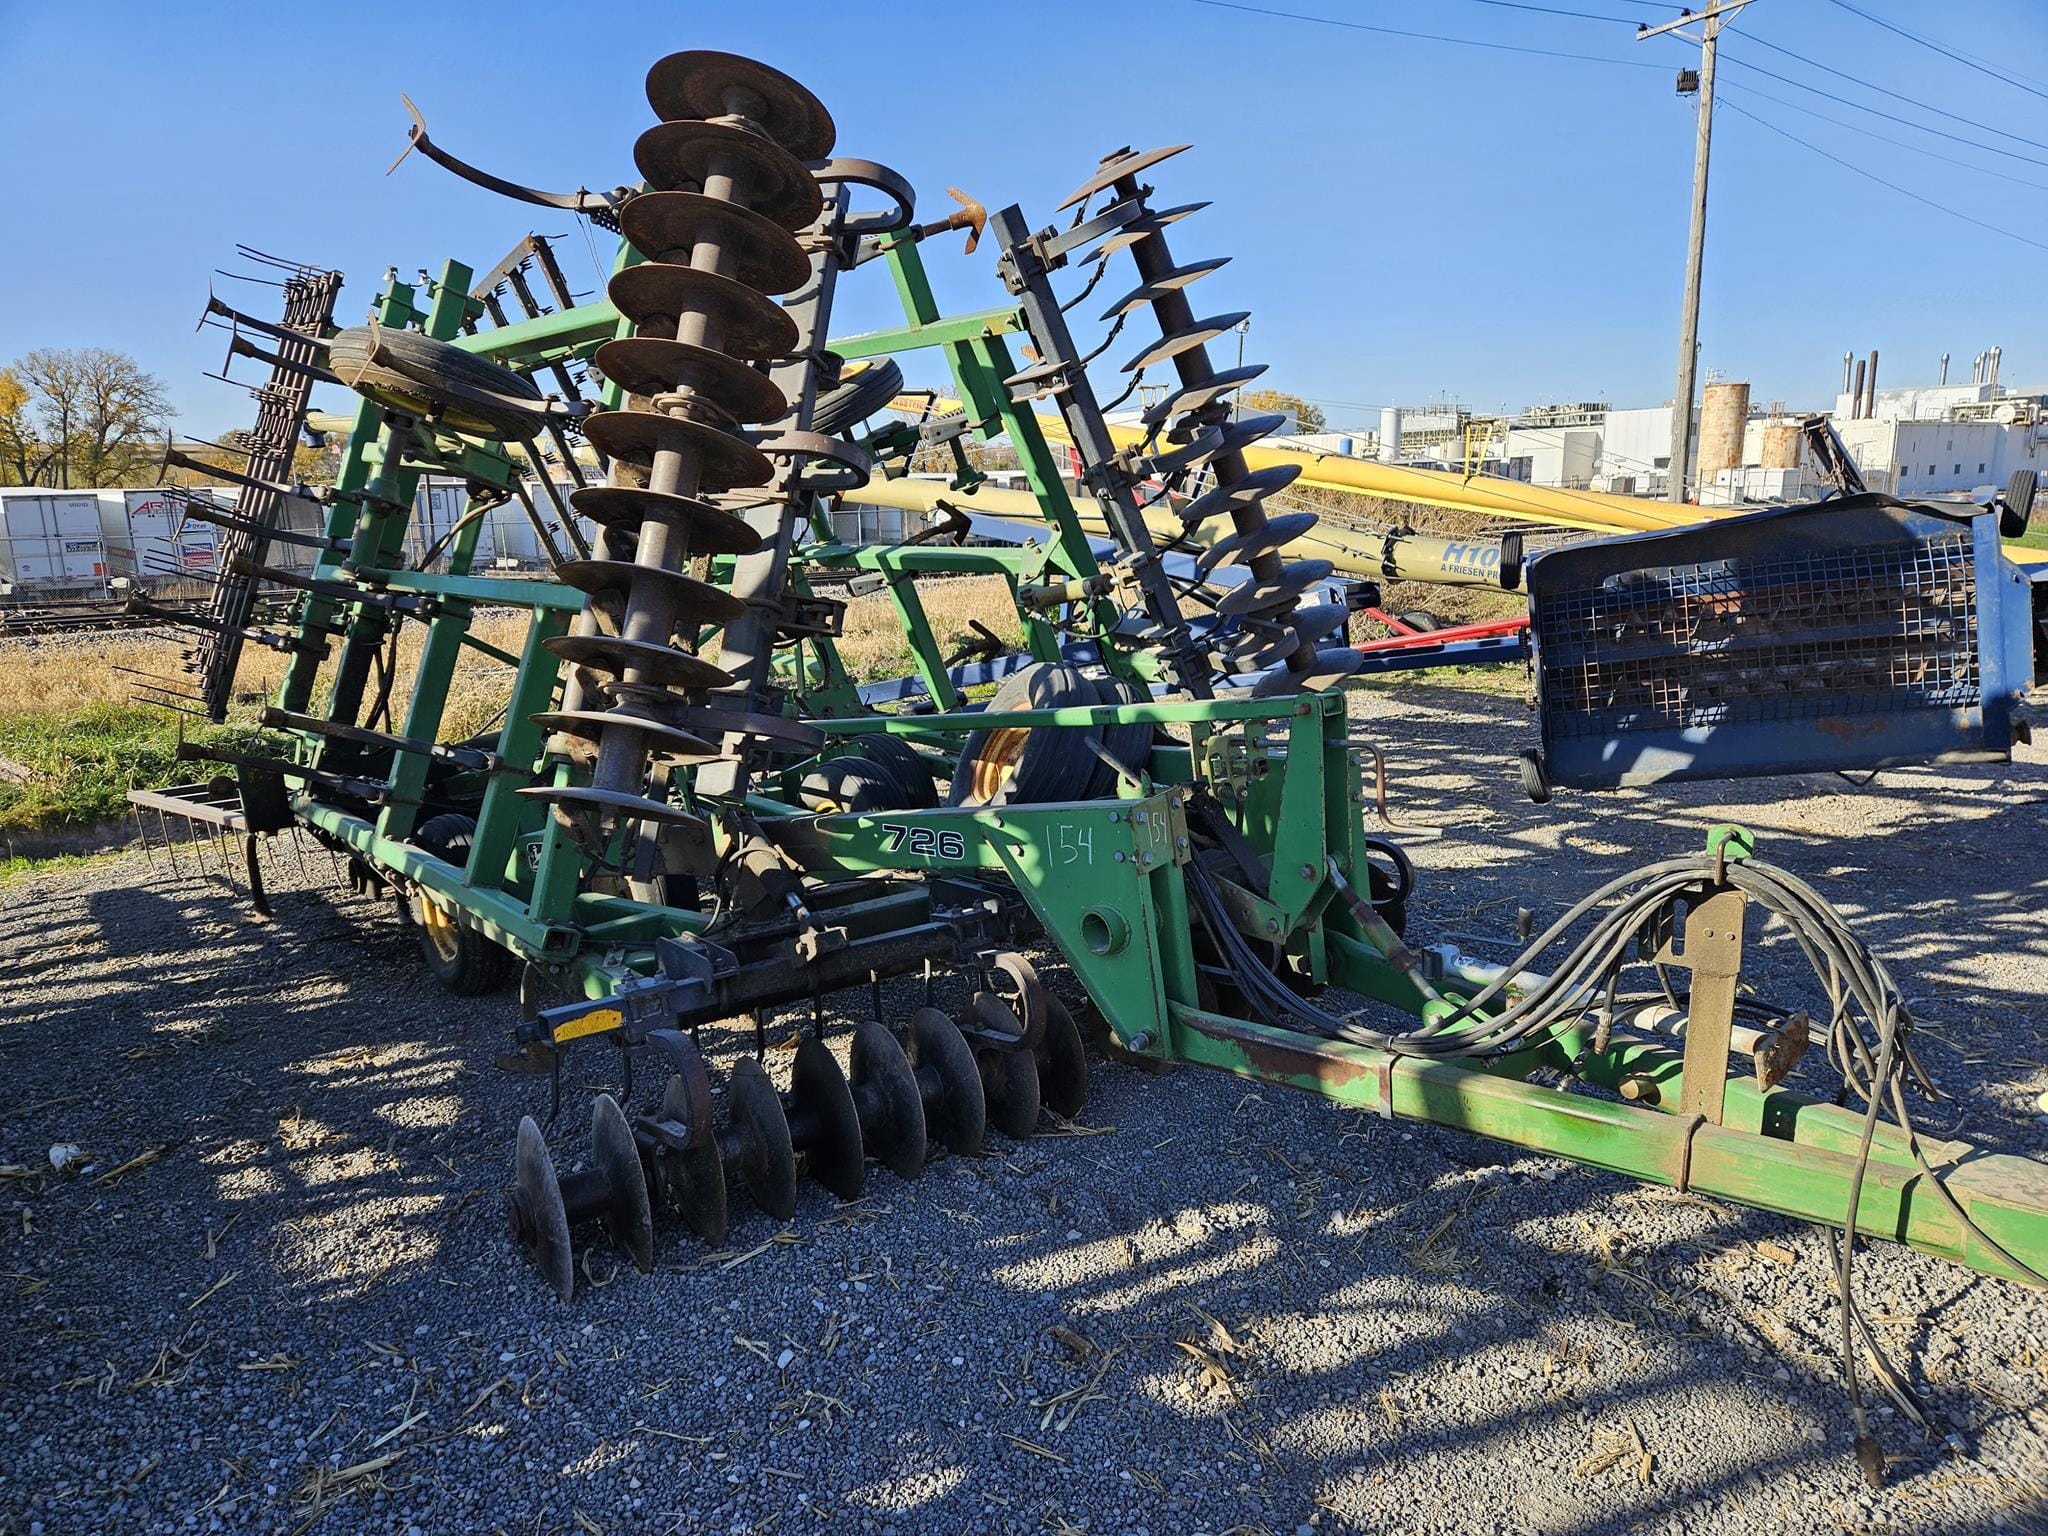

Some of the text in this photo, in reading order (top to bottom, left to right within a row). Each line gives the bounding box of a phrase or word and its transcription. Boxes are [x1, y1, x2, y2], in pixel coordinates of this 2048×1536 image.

[1440, 564, 1501, 580] A FRIESEN PR
[1443, 543, 1501, 568] H10
[881, 823, 965, 860] 726
[1046, 824, 1094, 868] 154
[1148, 812, 1167, 848] 154
